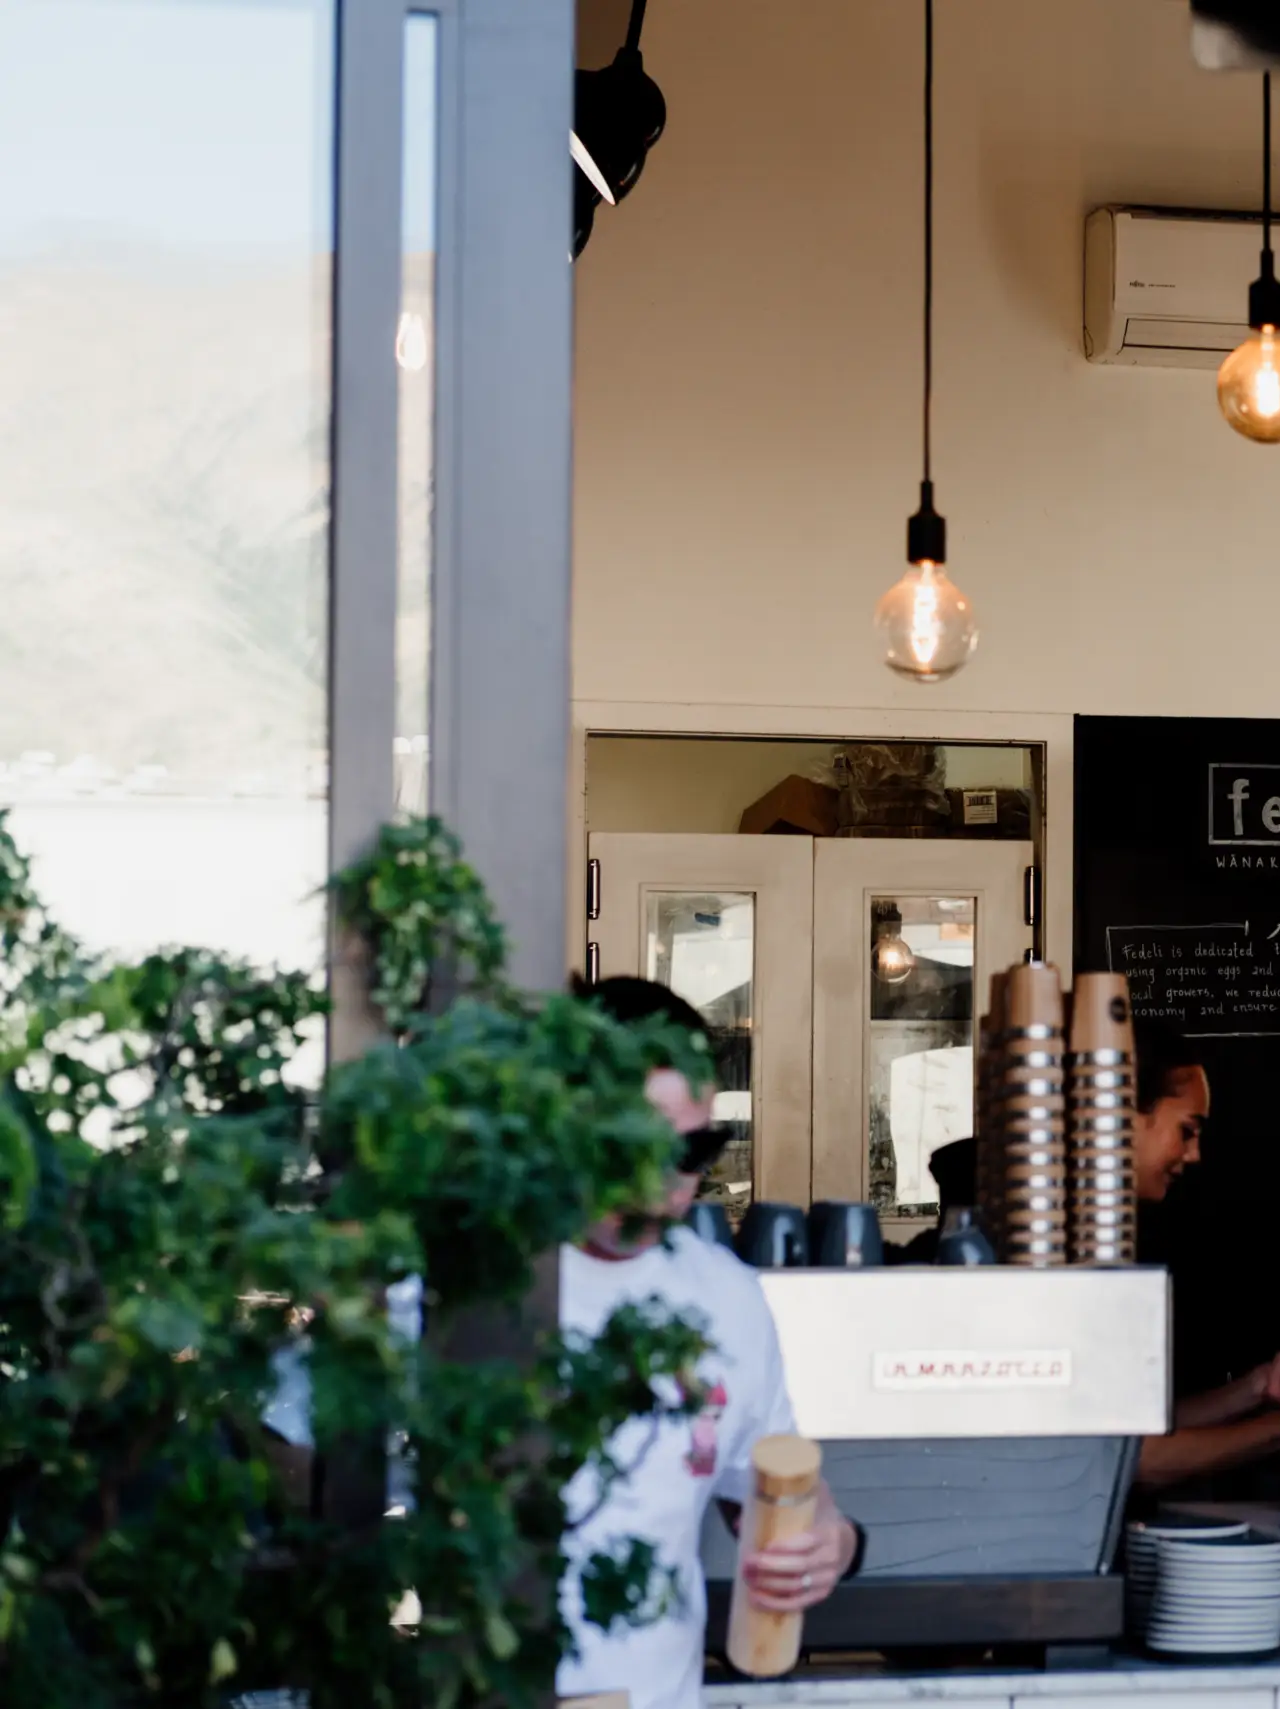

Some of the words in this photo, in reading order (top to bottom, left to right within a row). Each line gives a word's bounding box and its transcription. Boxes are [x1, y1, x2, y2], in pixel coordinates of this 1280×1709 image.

[1121, 943, 1163, 960] Fedeli
[1171, 944, 1183, 957] is
[1194, 942, 1254, 958] dedicated
[1125, 965, 1155, 984] using
[1165, 963, 1208, 982] organic
[1217, 965, 1241, 980] eggs
[1252, 961, 1274, 976] and
[1130, 985, 1154, 1001] ocal
[1225, 988, 1239, 998] we
[1199, 1001, 1226, 1016] and
[1233, 1001, 1279, 1013] ensure
